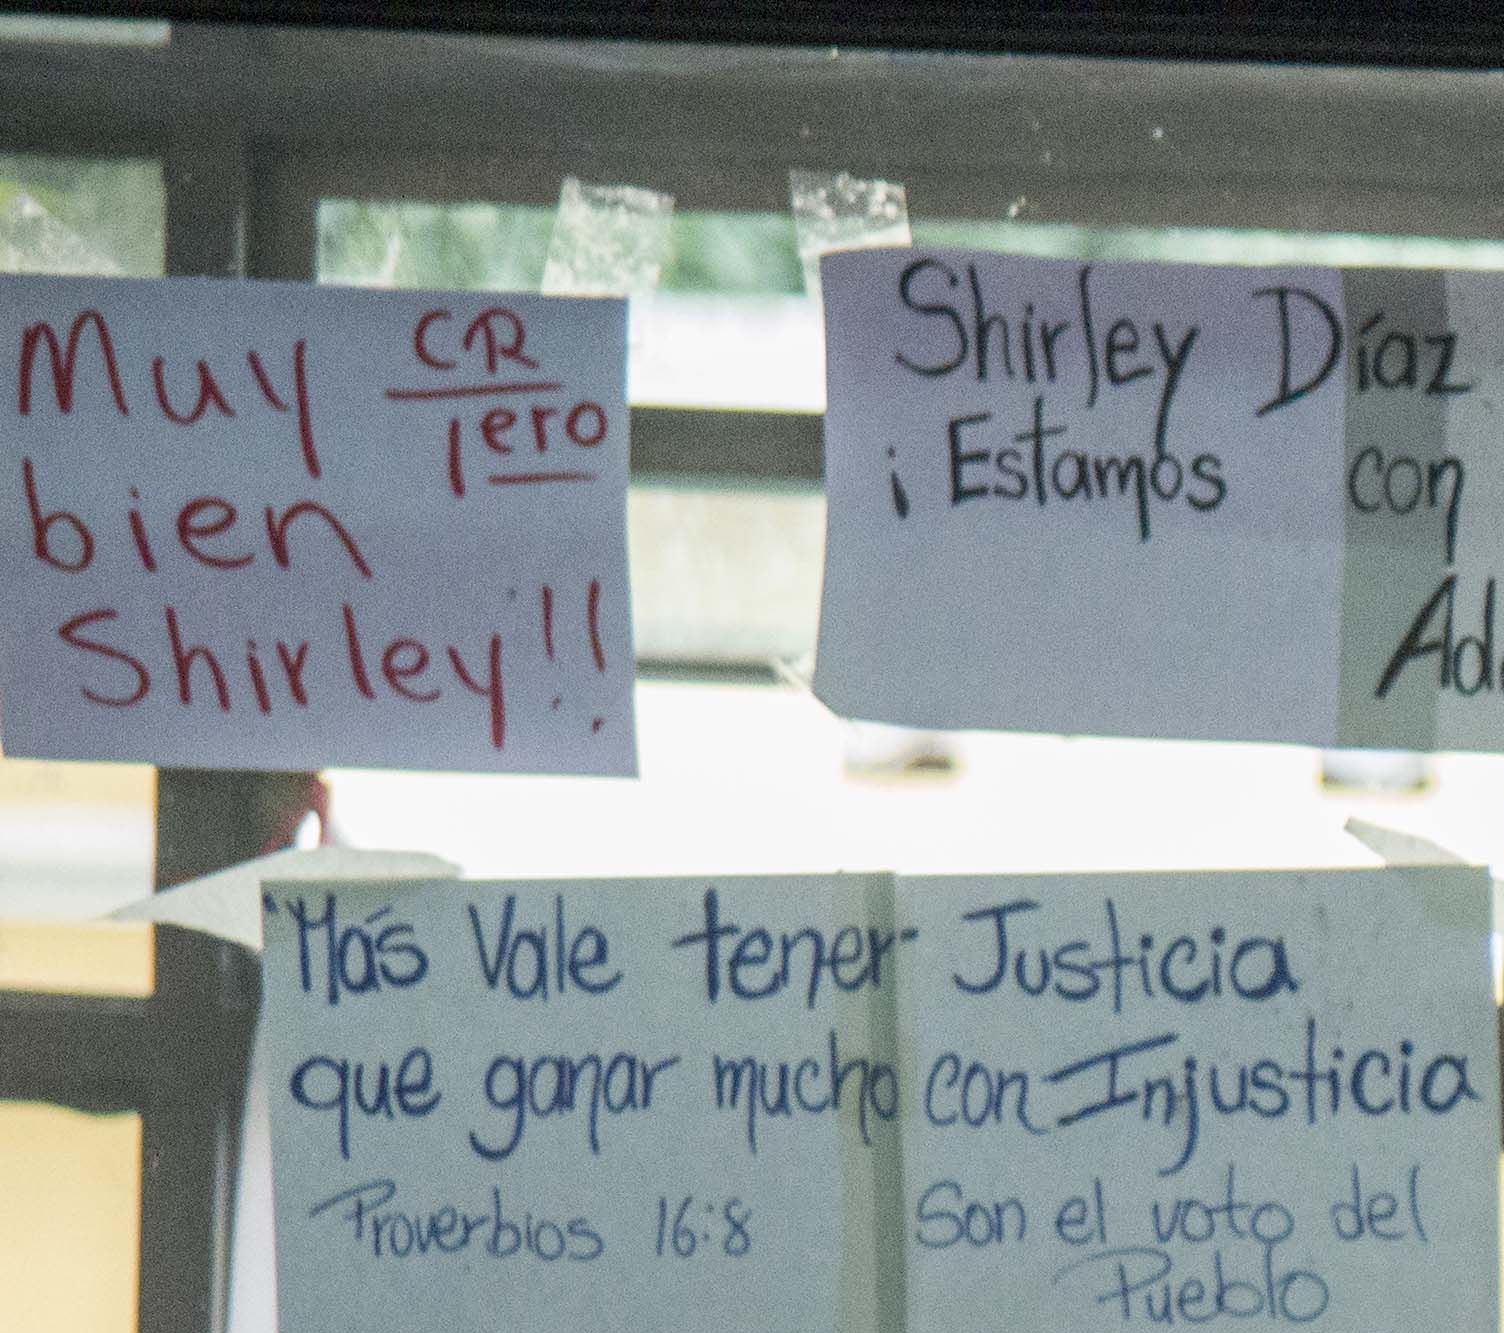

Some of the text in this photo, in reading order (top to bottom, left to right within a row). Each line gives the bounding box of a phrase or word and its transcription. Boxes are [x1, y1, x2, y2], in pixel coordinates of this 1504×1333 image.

[18, 309, 321, 478] Muy
[413, 307, 539, 373] CR
[895, 257, 1475, 455] Shirley Díaz
[22, 458, 372, 578] bien
[1348, 446, 1463, 564] con
[468, 894, 622, 1001] Vale
[673, 888, 918, 1009] tener
[954, 899, 1299, 1014] Justicia
[290, 1016, 1483, 1178] que ganar mucho con Injusticia
[308, 1178, 605, 1260] Proverbios
[1055, 1178, 1107, 1246] el
[1152, 1163, 1293, 1246] voto
[1331, 1162, 1428, 1244] del
[1051, 1246, 1330, 1322] Pueblo
